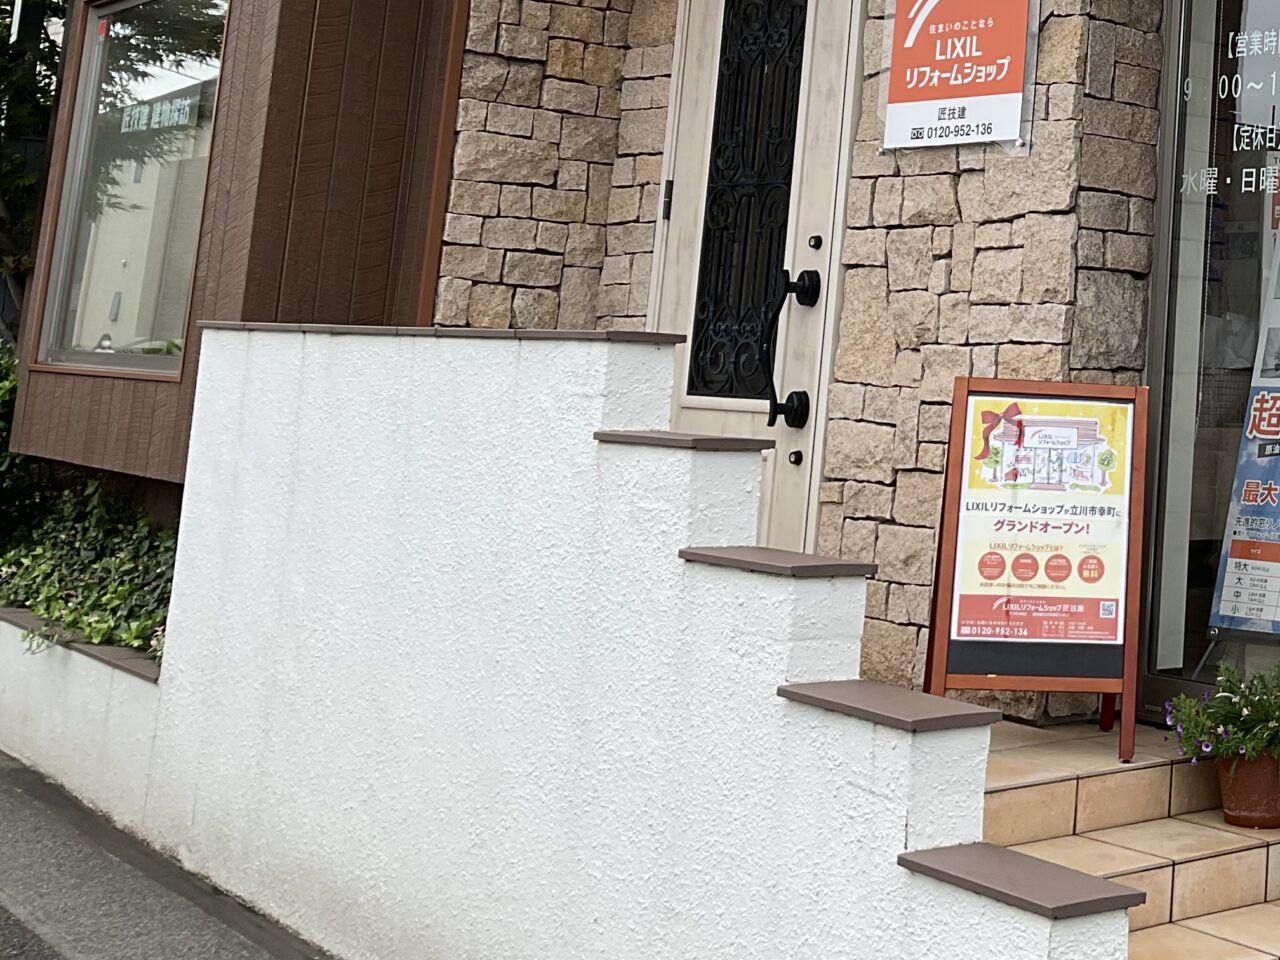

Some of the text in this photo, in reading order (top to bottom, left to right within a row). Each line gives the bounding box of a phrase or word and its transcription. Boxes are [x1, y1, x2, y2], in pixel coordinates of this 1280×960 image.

[929, 17, 995, 35] 住まいのことなら
[935, 36, 983, 61] LIXIL
[906, 55, 1011, 89] リフォームショップ
[938, 106, 967, 121] 匠技建
[927, 123, 993, 138] 0120-952-136
[993, 519, 1090, 535] グランドオープン!
[971, 626, 1028, 636] 0120-952-136
